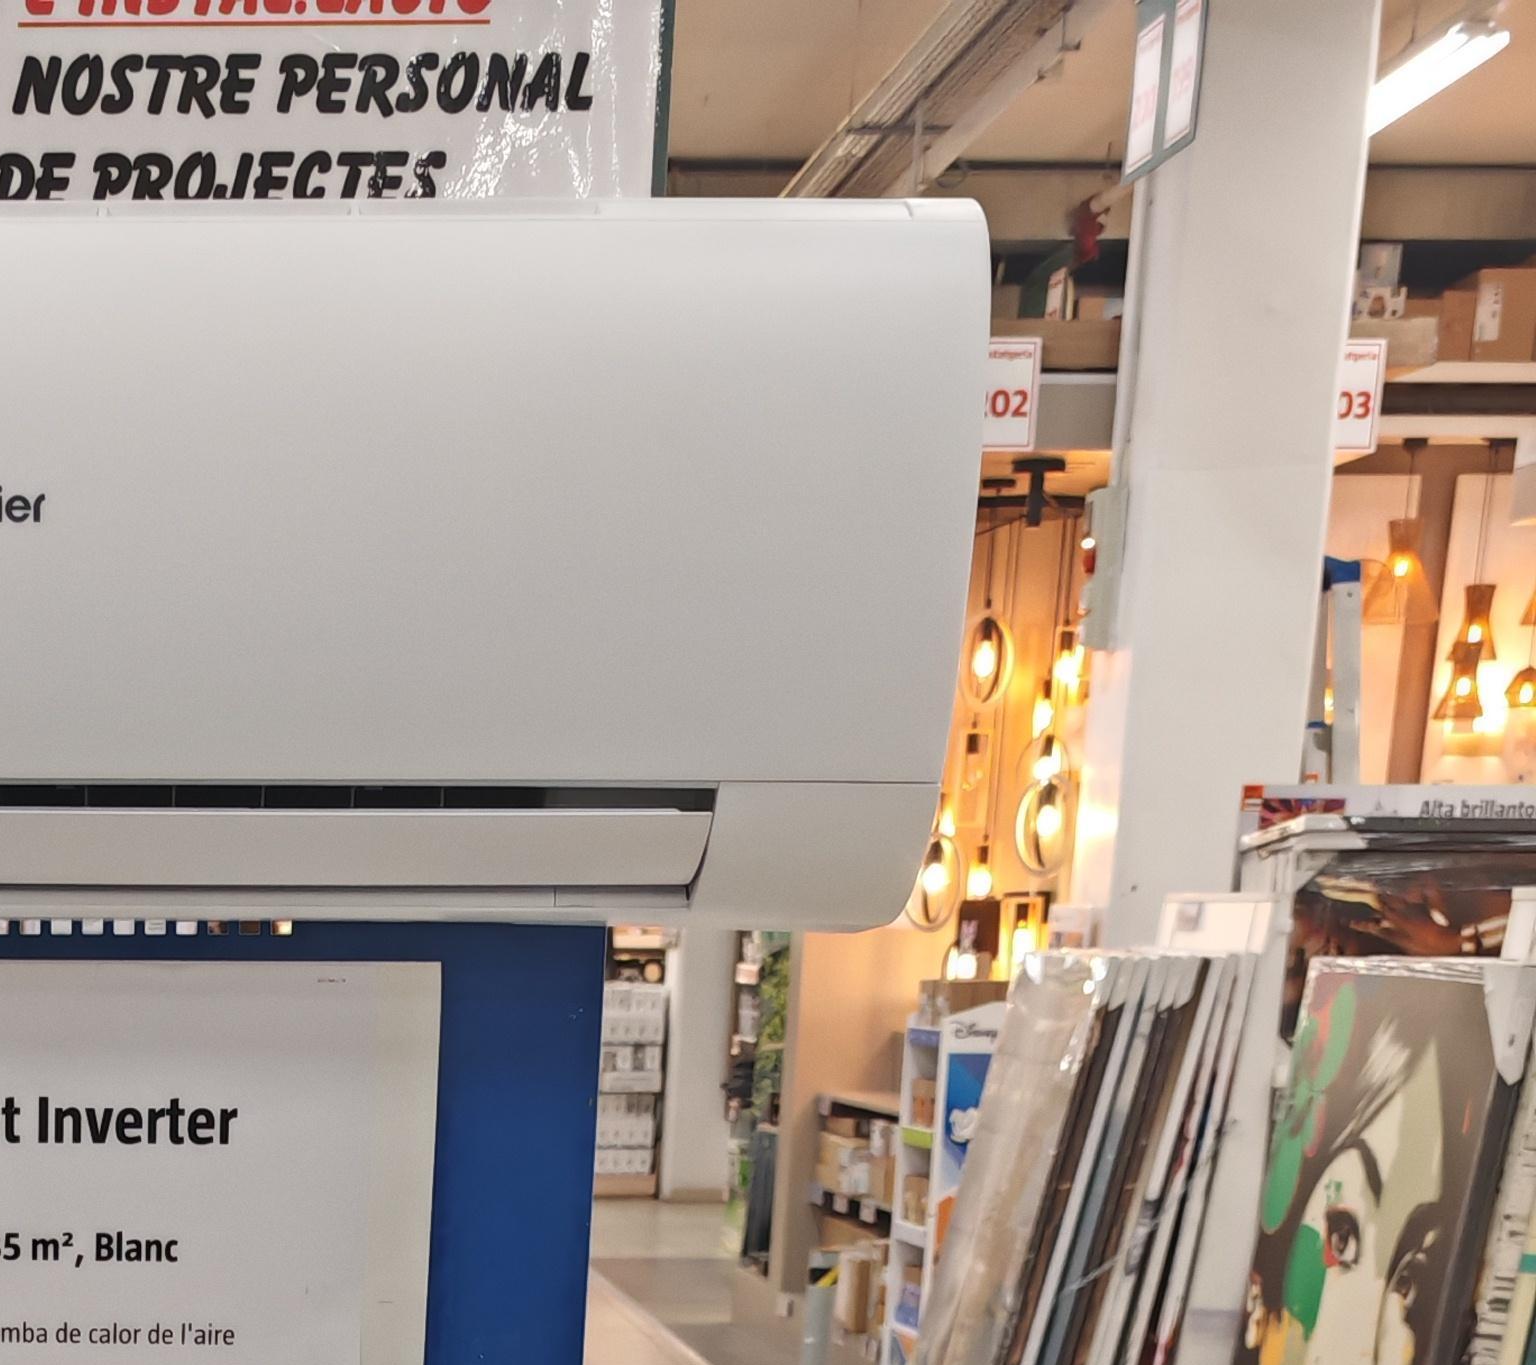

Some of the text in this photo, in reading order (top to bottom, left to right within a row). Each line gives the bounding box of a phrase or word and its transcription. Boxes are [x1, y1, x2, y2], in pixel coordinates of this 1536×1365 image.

[13, 53, 263, 119] NOSTRE
[278, 51, 594, 119] PERSONAL
[92, 150, 448, 200] PROJECTES
[37, 1095, 239, 1146] Inverter
[94, 1230, 179, 1263] Blanc
[55, 1321, 82, 1344] de
[88, 1321, 142, 1345] calor
[147, 1322, 174, 1345] de
[180, 1322, 236, 1346] l'aire
